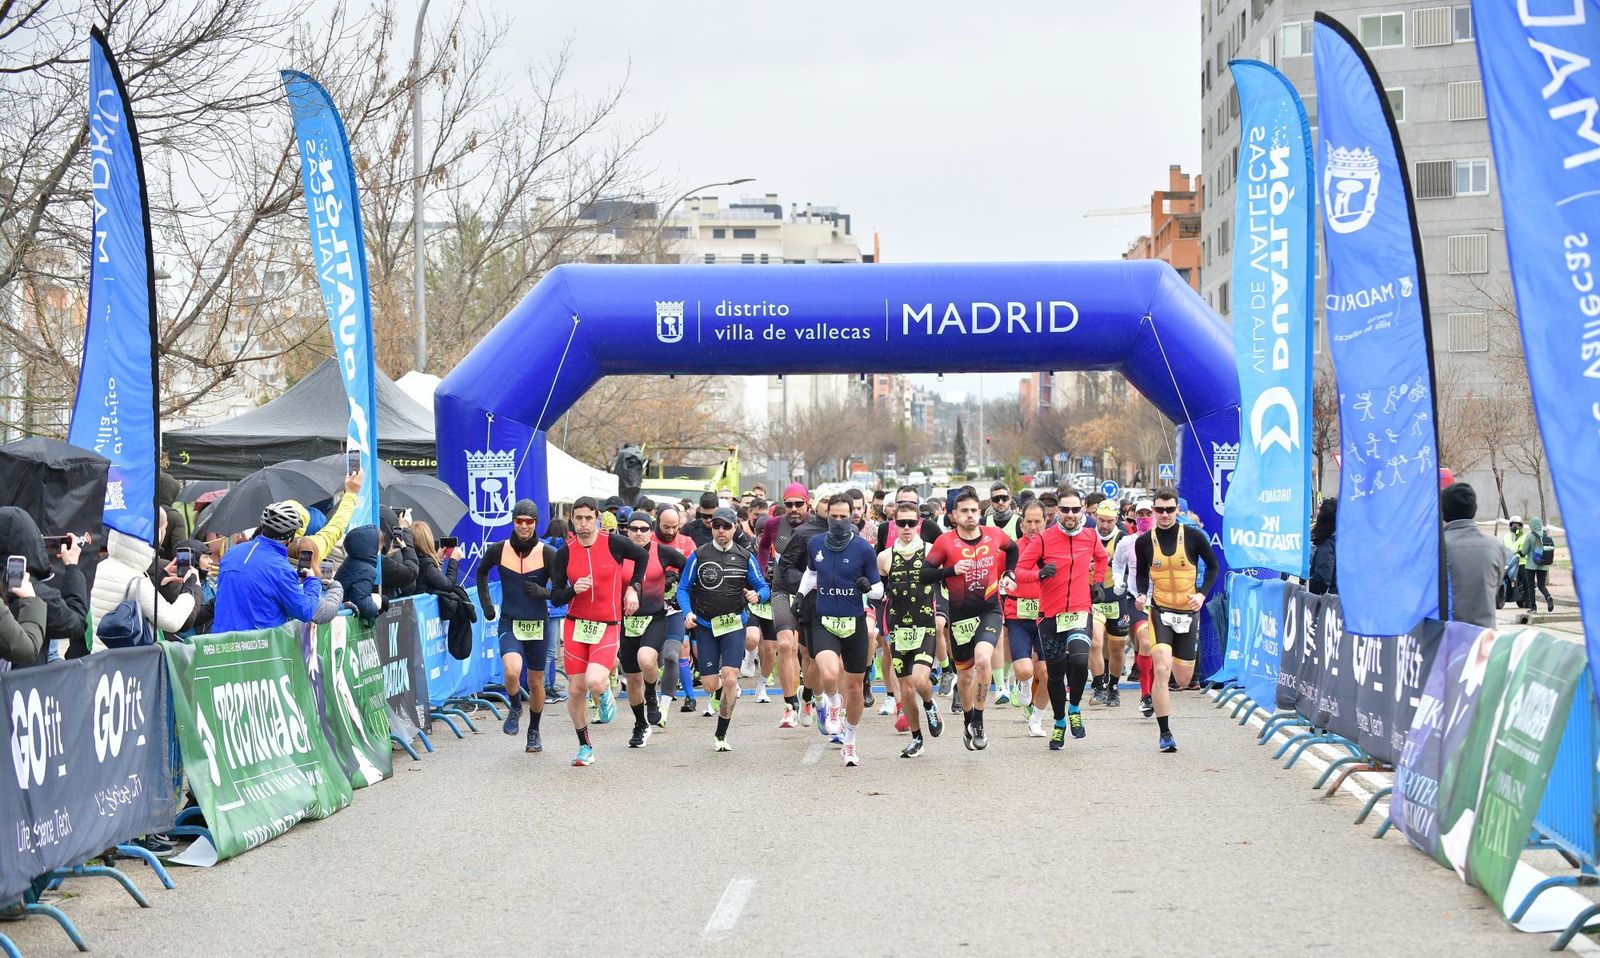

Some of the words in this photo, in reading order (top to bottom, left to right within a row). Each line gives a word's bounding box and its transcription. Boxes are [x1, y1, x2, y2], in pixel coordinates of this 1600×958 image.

[715, 299, 790, 317] distrito
[902, 301, 1079, 335] MADRID
[715, 323, 754, 341] villa
[763, 323, 786, 340] de
[794, 323, 871, 340] vallecas
[965, 570, 989, 582] ESP
[1025, 602, 1037, 611] 216
[521, 622, 535, 632] 307
[583, 624, 598, 635] 356
[631, 620, 644, 629] 322
[832, 621, 846, 629] 176
[959, 623, 974, 634] 340
[94, 670, 145, 764] GOfit
[11, 687, 65, 790] GOfit
